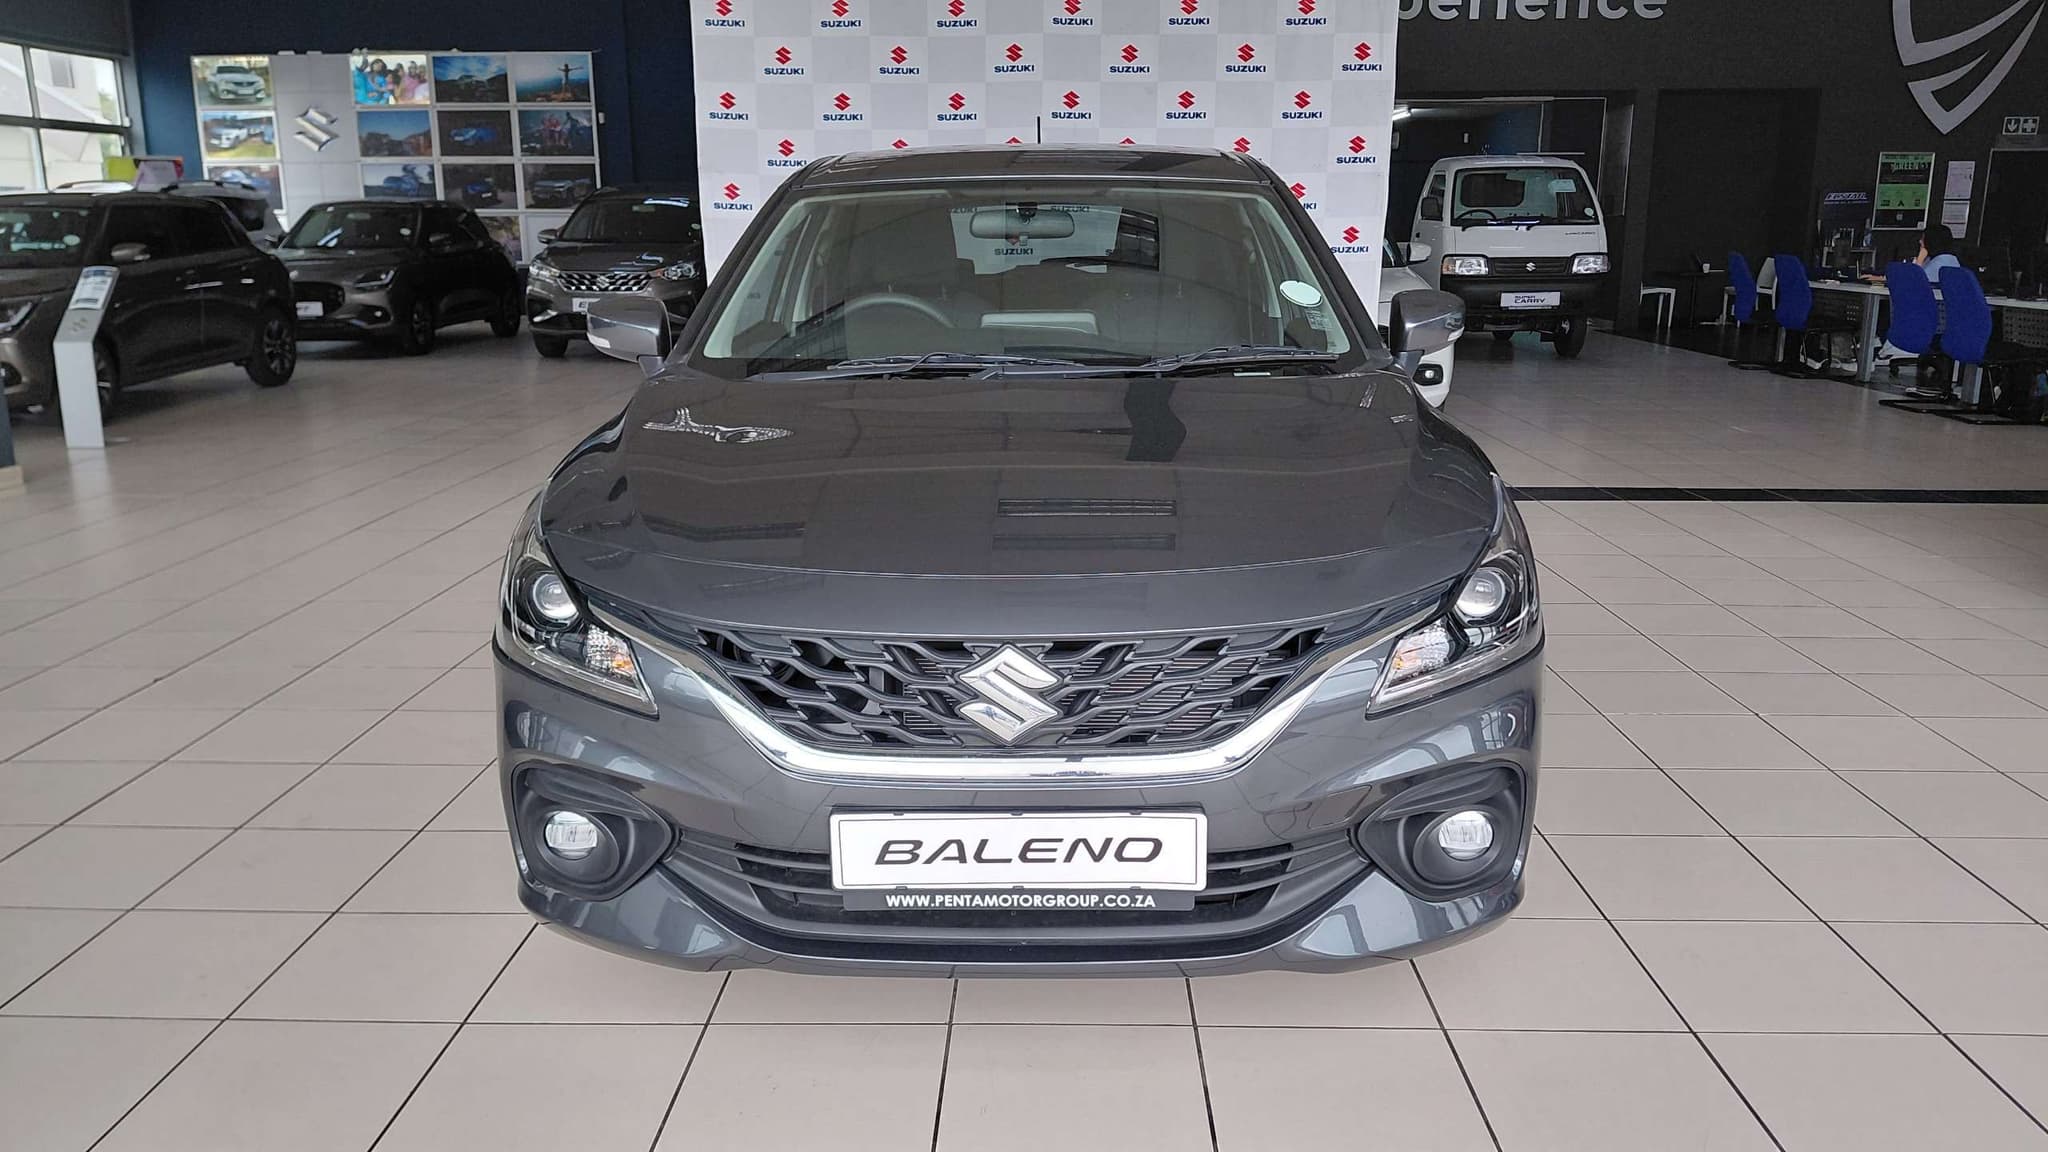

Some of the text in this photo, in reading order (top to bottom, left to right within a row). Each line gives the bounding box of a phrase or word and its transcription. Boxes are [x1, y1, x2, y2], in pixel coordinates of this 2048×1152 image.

[704, 18, 745, 27] SUZUKI
[820, 19, 862, 28] SUZUKI
[936, 19, 977, 28] SUZUKI
[1052, 17, 1094, 26] SUZUKI
[1168, 17, 1210, 26] SUZUKI
[1285, 17, 1327, 26] SUZUKI
[763, 67, 805, 76] SUZUKI
[879, 67, 920, 76] SUZUKI
[993, 64, 1035, 73] SUZUKI
[1109, 65, 1150, 74] SUZUKI
[1225, 64, 1266, 73] SUZUKI
[1342, 63, 1383, 72] SUZUKI
[709, 112, 749, 121] SUZUKI
[822, 113, 863, 122] SUZUKI
[936, 113, 977, 122] SUZUKI
[1051, 111, 1092, 120] SUZUKI
[1165, 111, 1207, 120] SUZUKI
[1281, 111, 1323, 120] SUZUKI
[1336, 156, 1376, 164] SUZUKI
[713, 202, 753, 211] SUZUKI
[994, 248, 1034, 256] SUZUKI
[1330, 246, 1369, 254] SUZUKI
[874, 836, 1164, 866] BALENO
[885, 892, 1157, 909] WWW.PENTAMOTORGROUP.CO.ZA
